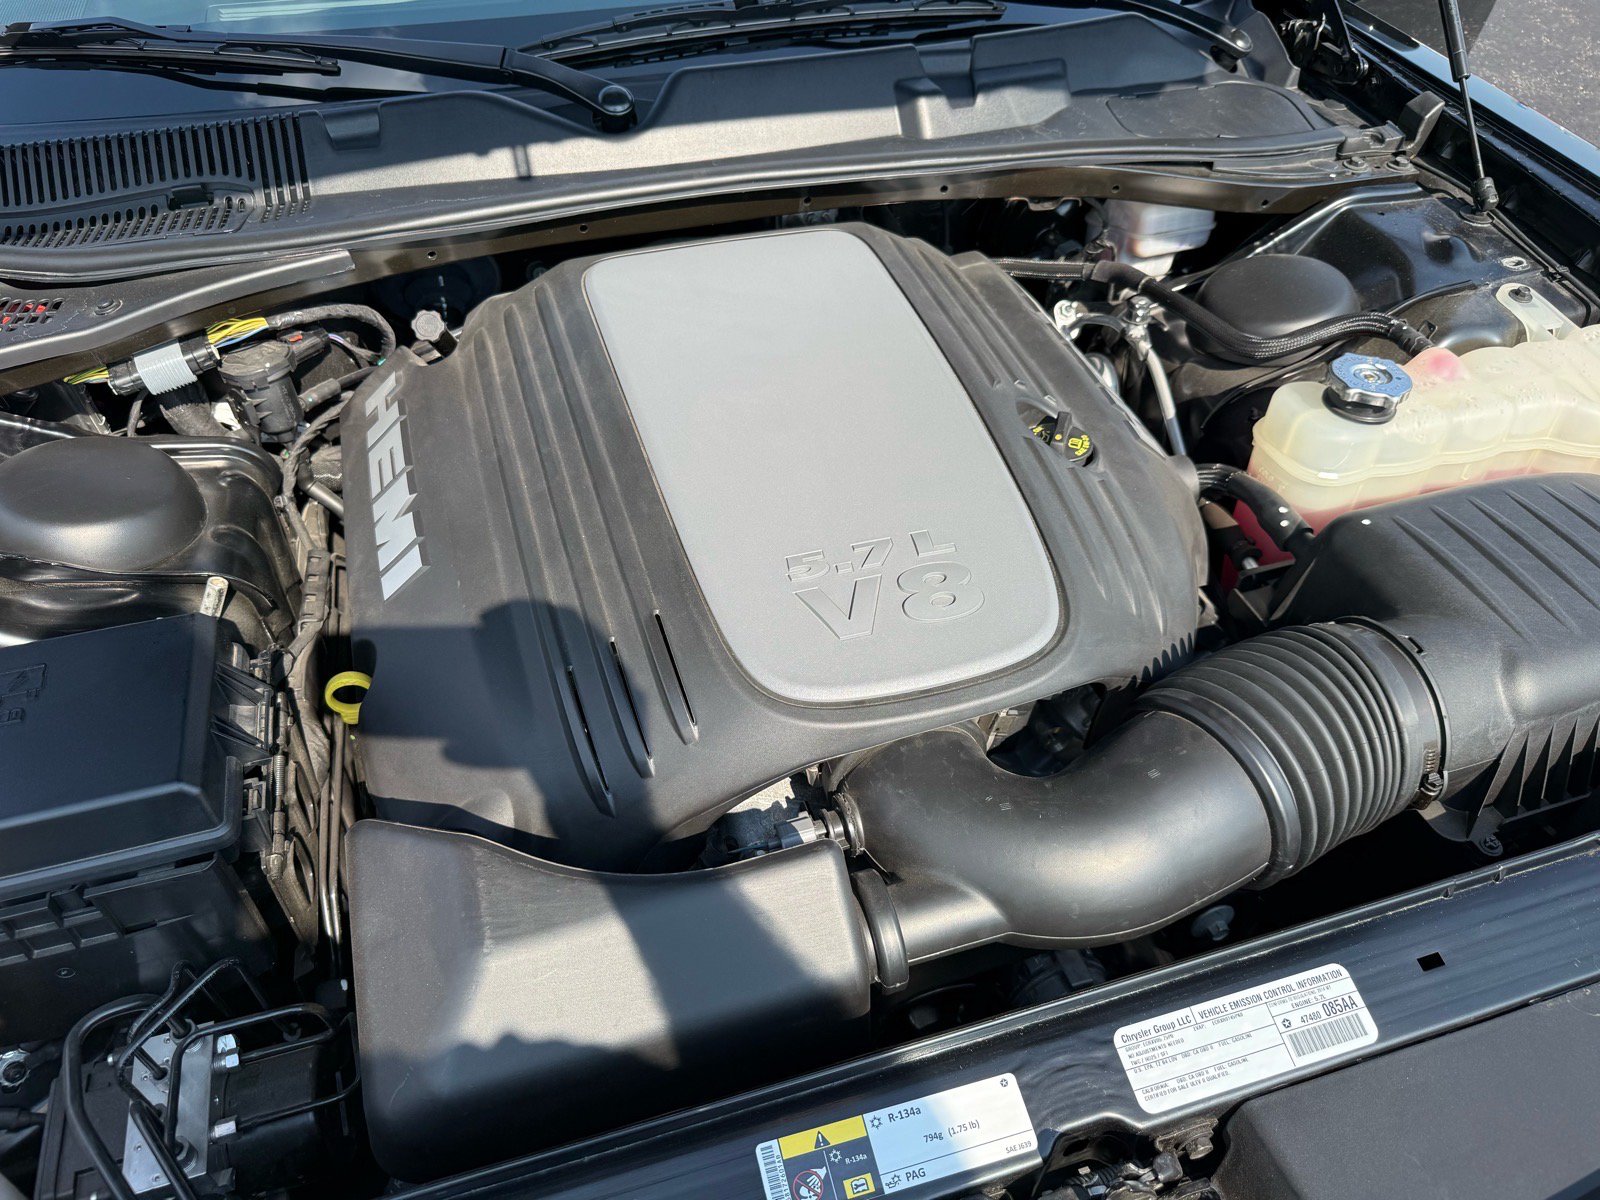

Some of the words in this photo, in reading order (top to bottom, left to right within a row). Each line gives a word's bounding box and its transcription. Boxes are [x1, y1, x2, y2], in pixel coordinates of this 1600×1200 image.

[365, 371, 426, 600] HEMI
[793, 560, 985, 640] V8
[1198, 1003, 1228, 1019] VEHICLE
[1228, 993, 1262, 1010] EMISSION
[1262, 983, 1295, 999] CONTROL
[1295, 969, 1342, 989] INFORMATION
[1291, 998, 1313, 1008] ENGINE:
[1299, 1010, 1321, 1024] 47480
[1321, 995, 1357, 1016] 085AA
[1120, 1026, 1153, 1044] Chrysler
[1152, 1019, 1176, 1034] Group
[1176, 1014, 1191, 1025] LLC
[888, 1106, 921, 1123] R-134a
[923, 1131, 944, 1143] 794g
[948, 1123, 968, 1138] (1.75
[967, 1119, 980, 1135] lb)
[845, 1153, 868, 1165] R-134a
[1005, 1143, 1019, 1154] SAE
[905, 1168, 927, 1182] PAG
